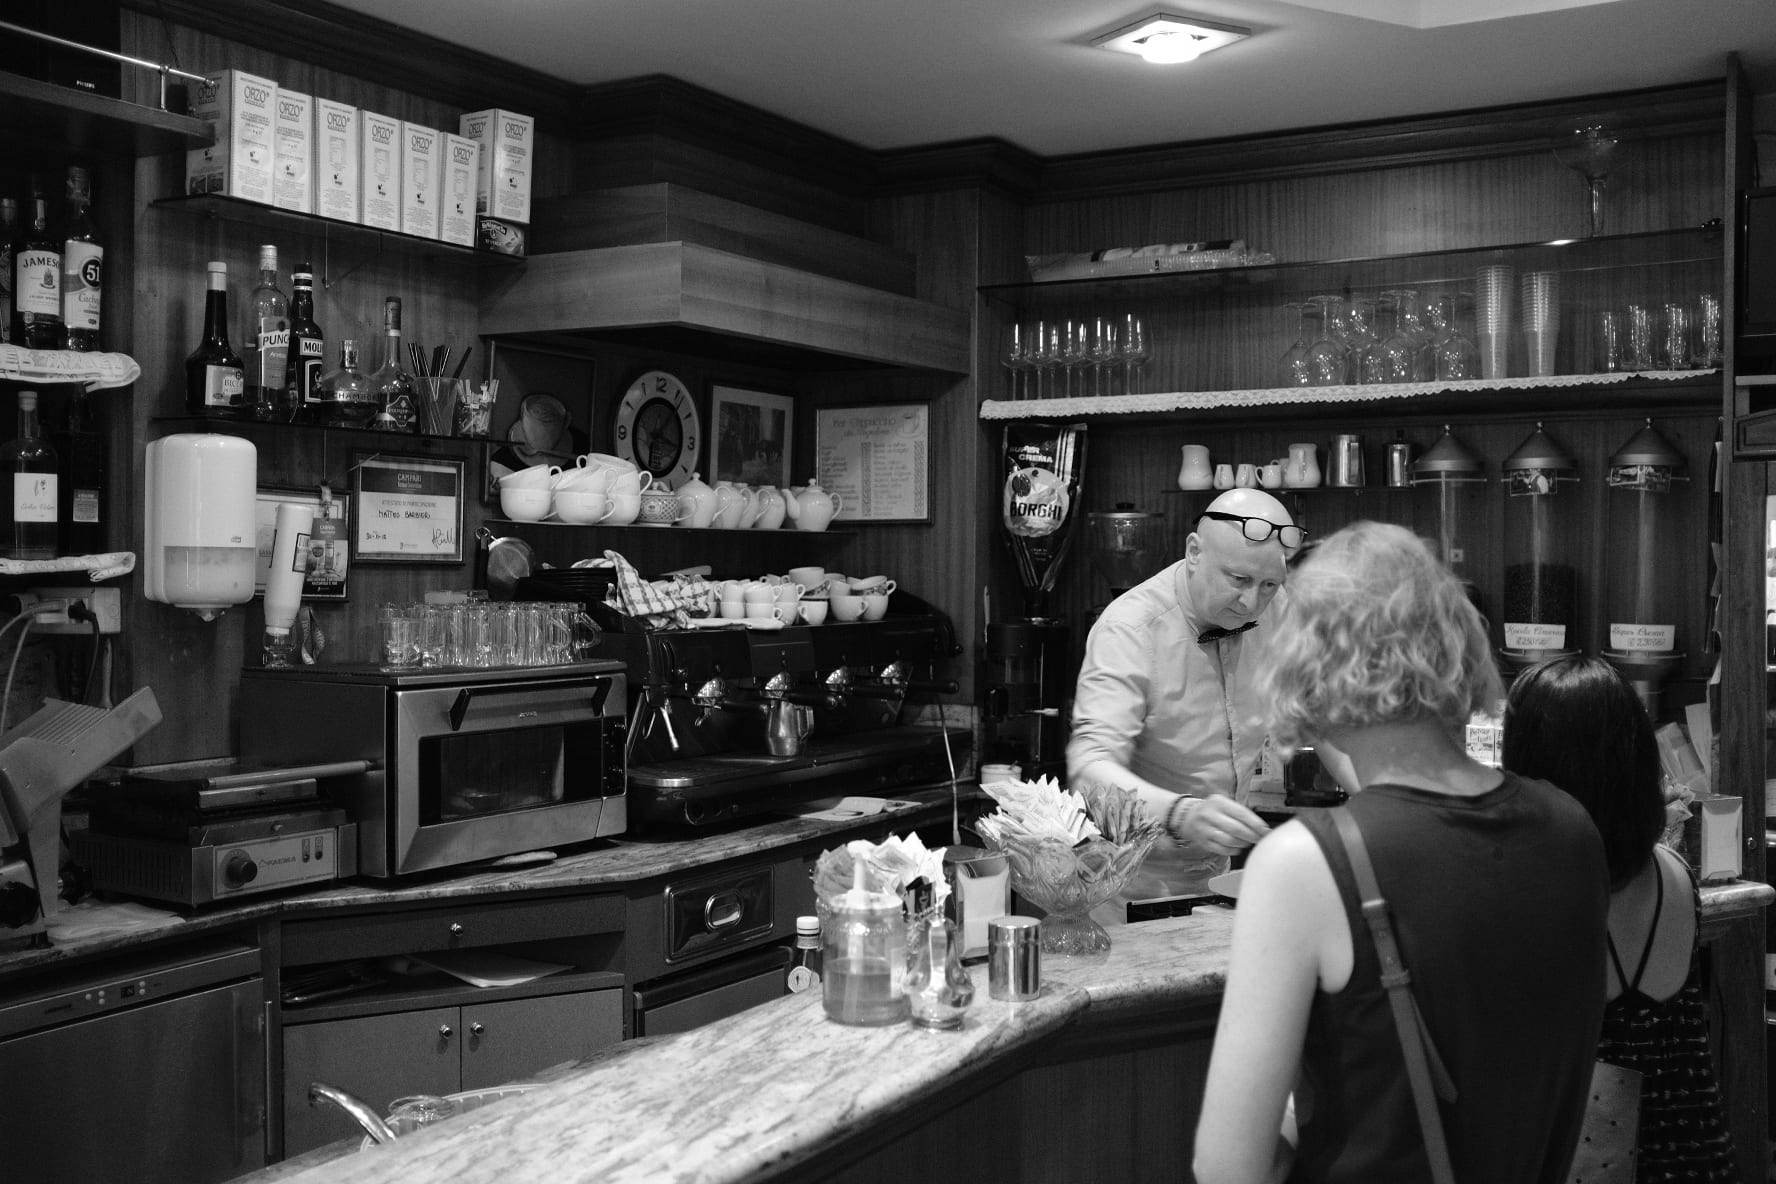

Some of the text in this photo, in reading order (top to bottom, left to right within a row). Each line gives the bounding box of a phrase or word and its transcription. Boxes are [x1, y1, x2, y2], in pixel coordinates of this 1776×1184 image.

[86, 264, 100, 282] 51
[263, 333, 290, 347] PUNC
[656, 377, 667, 393] 12
[618, 424, 627, 440] 9
[687, 436, 695, 450] 3
[1018, 453, 1053, 464] CREMA
[1010, 501, 1062, 521] BORGHI
